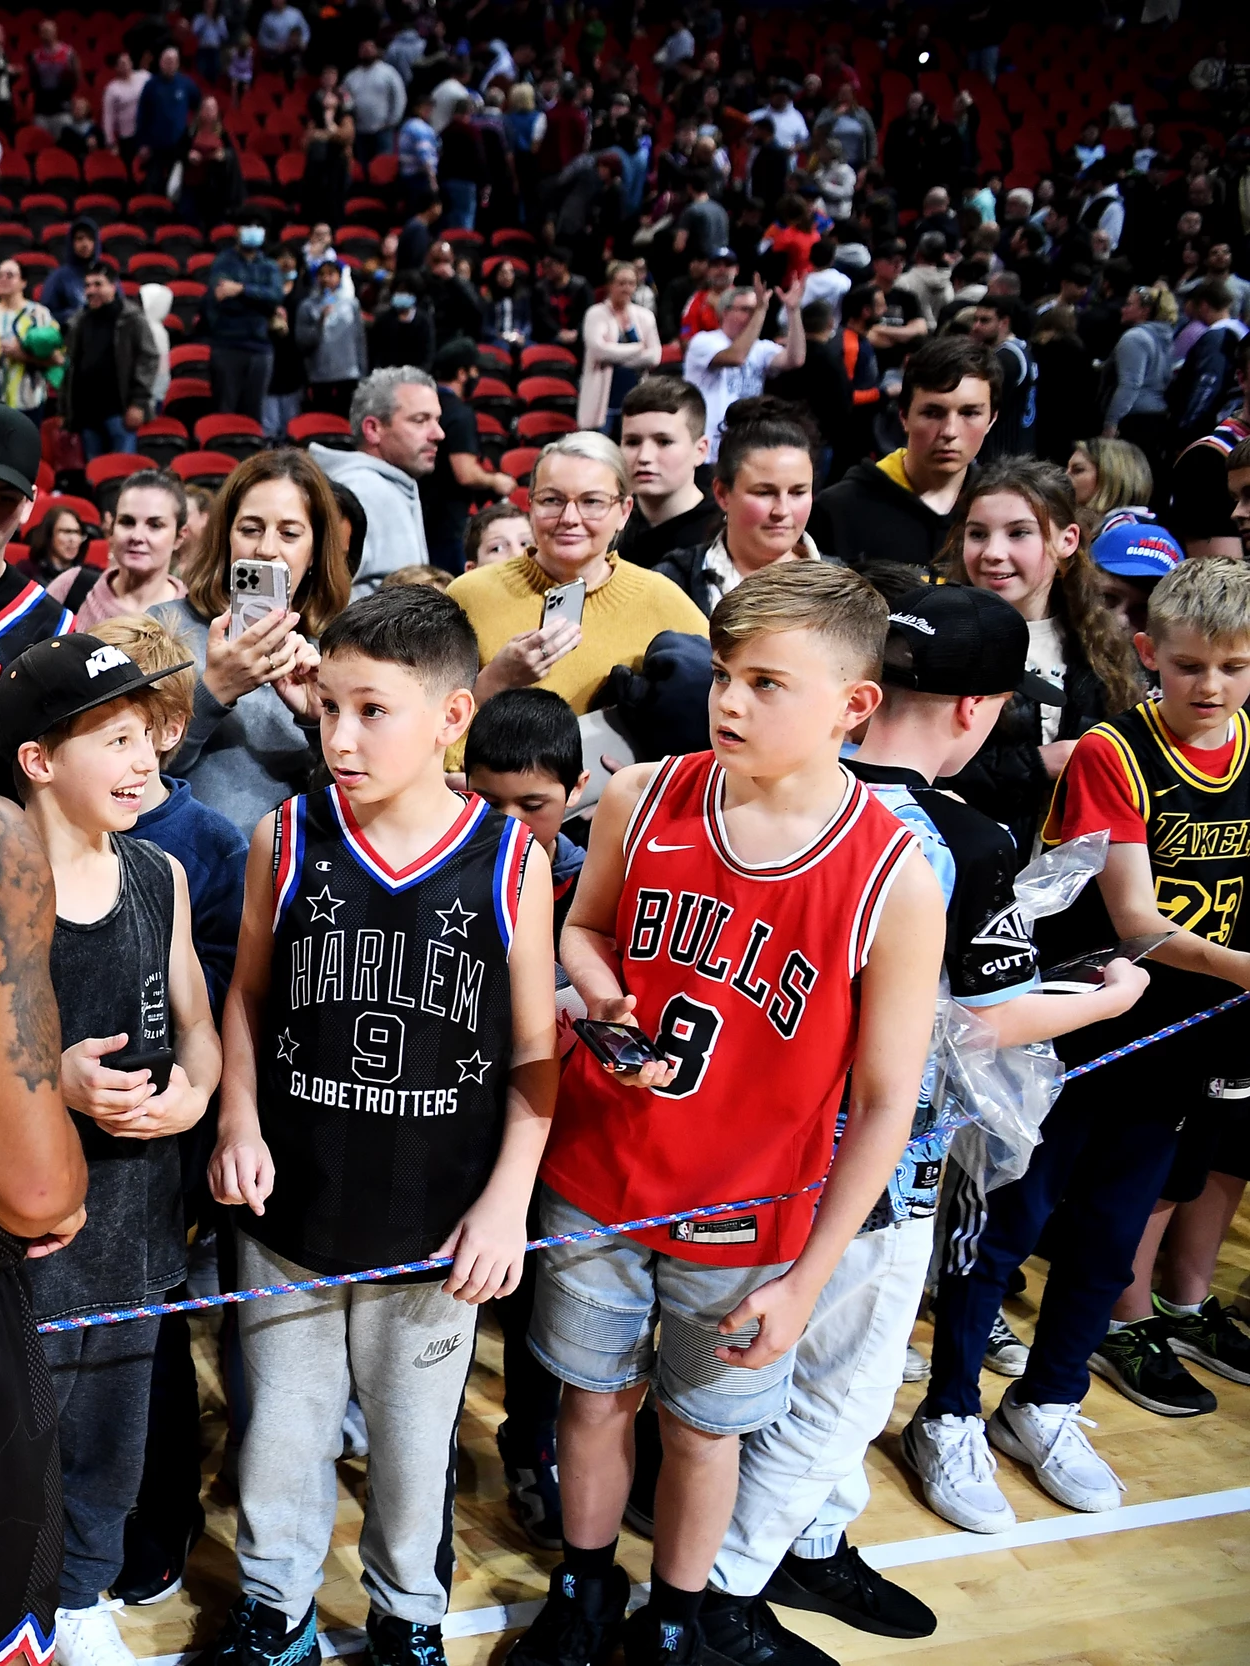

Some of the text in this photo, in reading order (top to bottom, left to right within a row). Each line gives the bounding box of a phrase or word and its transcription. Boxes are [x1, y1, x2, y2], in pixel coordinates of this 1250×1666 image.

[85, 645, 132, 679] KTM
[290, 929, 485, 1033] HARLEM
[628, 887, 819, 1041] BULLS
[351, 1011, 406, 1084] 9
[649, 992, 725, 1100] 8
[290, 1071, 459, 1117] GLOBETROTTERS
[423, 1332, 462, 1357] NIKE
